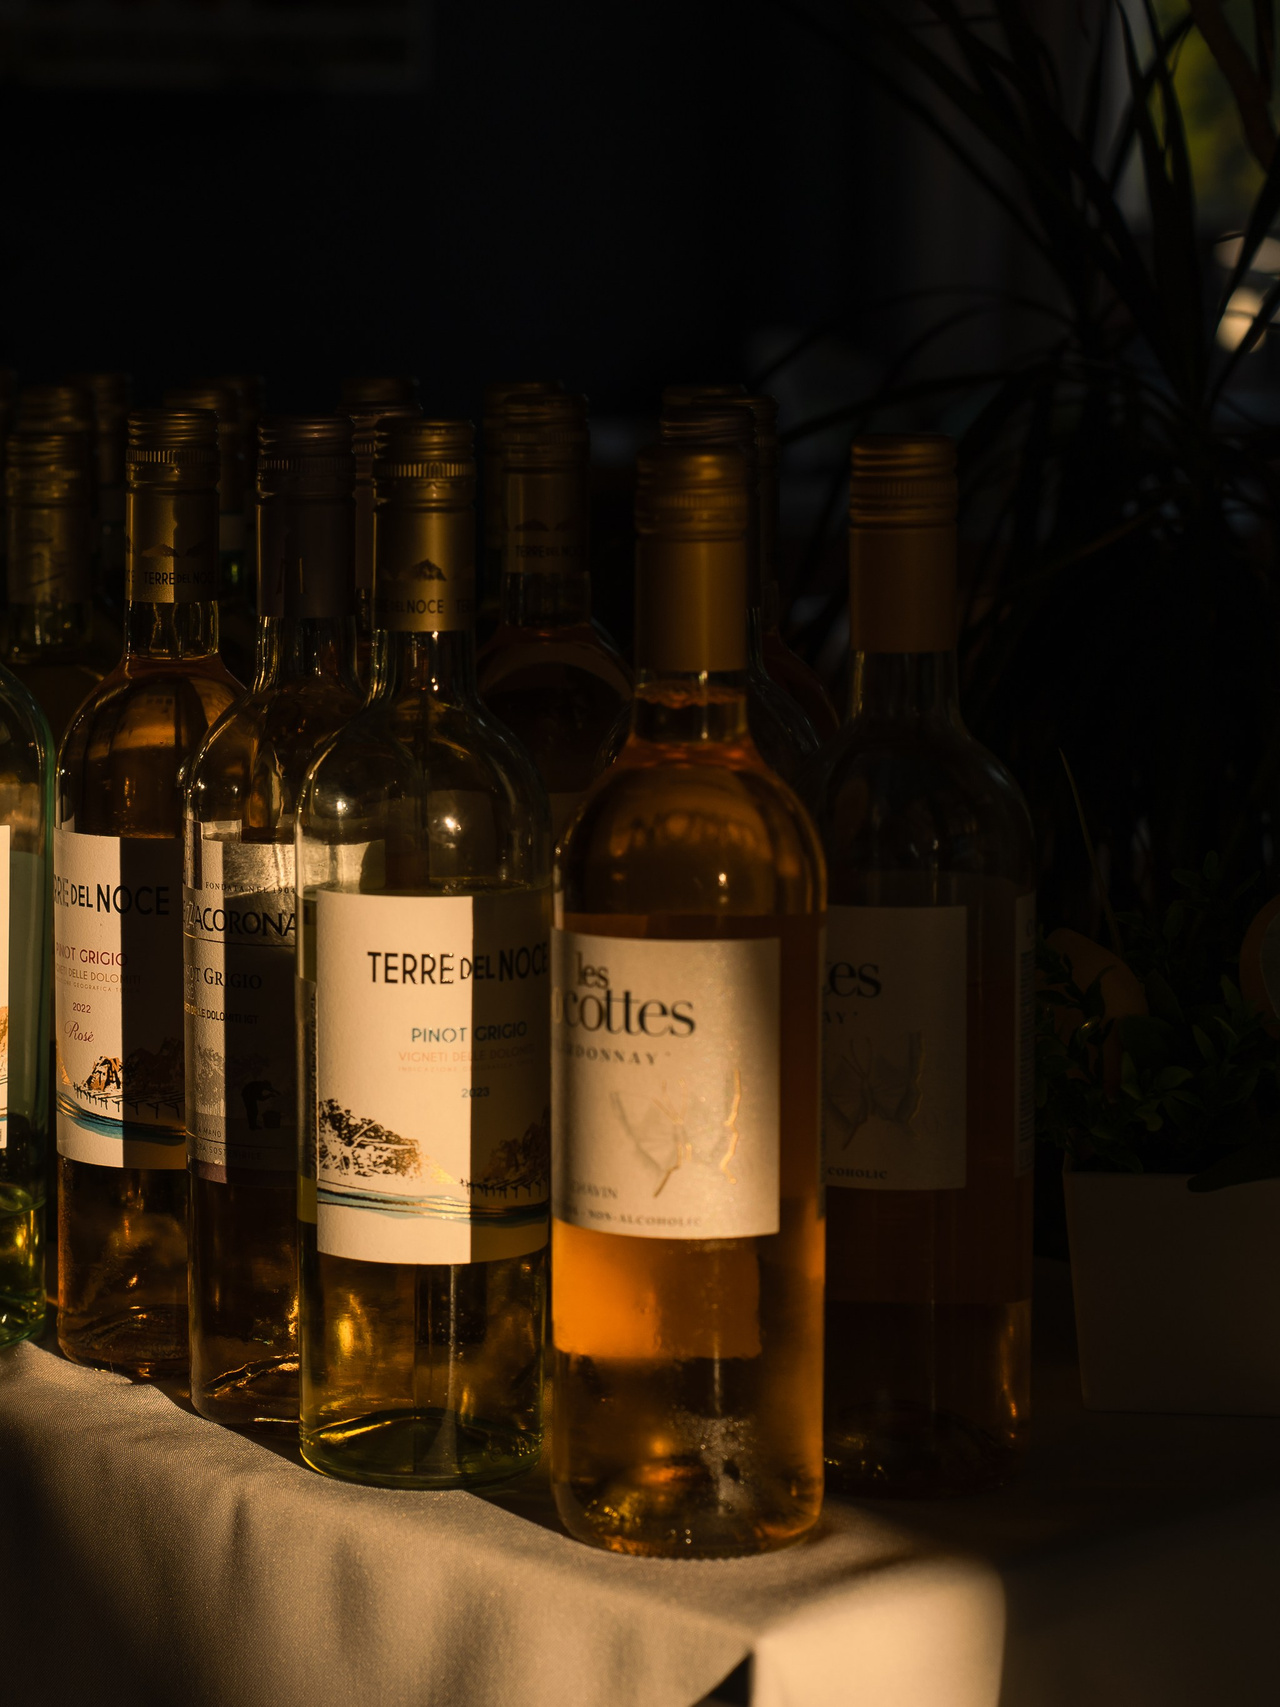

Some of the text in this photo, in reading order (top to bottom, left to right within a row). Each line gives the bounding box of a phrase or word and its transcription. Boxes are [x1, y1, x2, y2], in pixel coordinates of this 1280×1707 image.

[144, 571, 175, 585] TERRE
[407, 599, 444, 614] NOCE
[205, 881, 296, 894] FONDATA NEL 1904
[71, 883, 93, 908] DEL
[96, 883, 170, 915] NOCE
[79, 949, 129, 967] GRIGIO
[367, 942, 548, 984] TERRE DEL NOCE
[68, 967, 88, 980] DELLE
[90, 971, 141, 985] DOLOMITI
[577, 951, 609, 989] les
[73, 981, 111, 992] GEOGRAFICA
[72, 1002, 91, 1014] 2022
[563, 989, 696, 1038] cottes
[206, 1009, 242, 1023] DOLOMITI
[244, 1014, 260, 1024] IGT
[63, 1020, 95, 1042] Rosé
[411, 1021, 527, 1043] PINOT GRIGIO
[398, 1051, 448, 1063] VIGNETI
[452, 1050, 485, 1062] DELLE
[461, 1086, 490, 1098] 2023
[827, 1166, 888, 1180] COHOLIC
